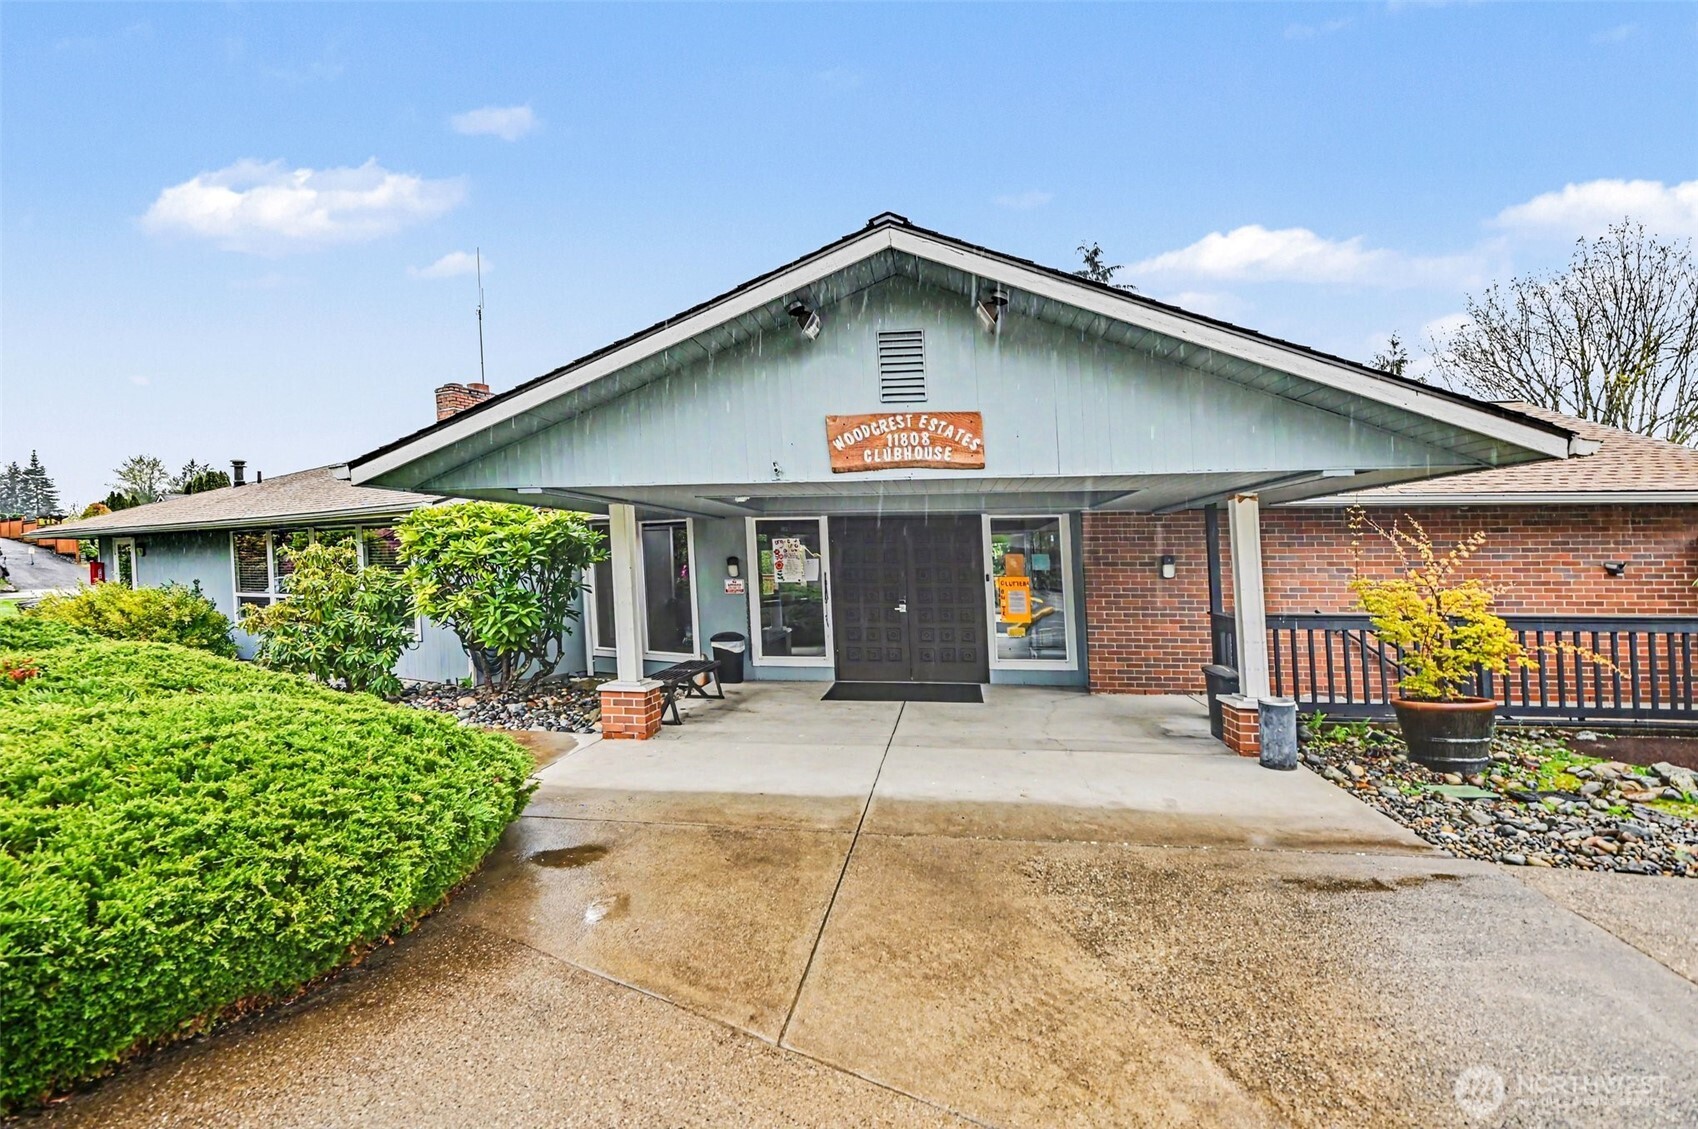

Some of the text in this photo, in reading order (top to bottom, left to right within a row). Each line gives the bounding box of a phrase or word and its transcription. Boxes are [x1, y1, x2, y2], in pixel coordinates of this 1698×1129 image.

[832, 414, 981, 451] WOODCREST ESTATES
[886, 432, 930, 447] 11808
[863, 447, 953, 463] CLUBHOUSE
